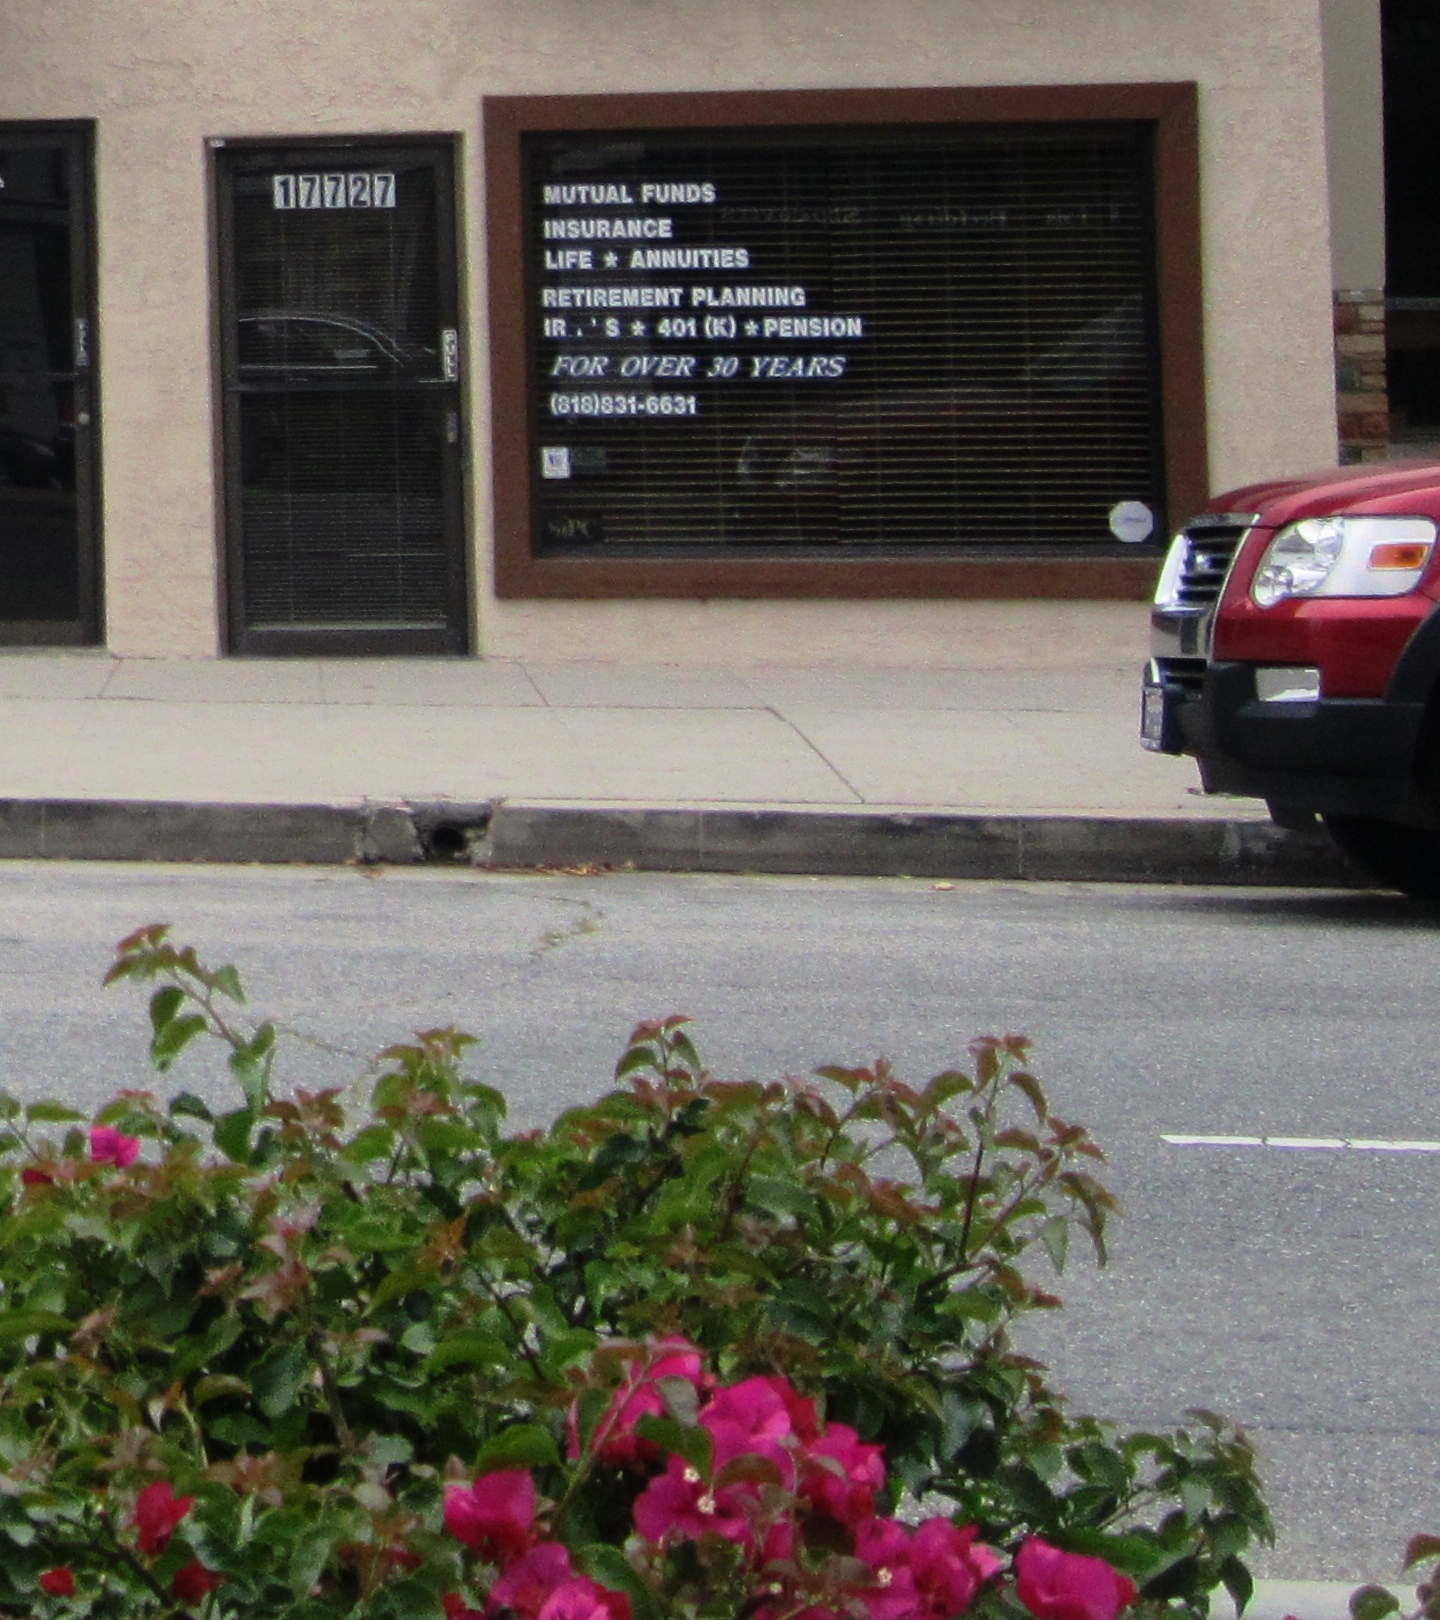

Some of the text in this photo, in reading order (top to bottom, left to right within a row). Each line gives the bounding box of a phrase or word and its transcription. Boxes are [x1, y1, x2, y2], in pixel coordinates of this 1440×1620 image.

[275, 174, 395, 208] 17727
[543, 183, 717, 204] MUTUAL FUNDS
[543, 218, 673, 238] INSURANCE
[544, 248, 750, 269] LIFE ANNUITIES
[542, 287, 806, 307] RETIREMENT PLANNING
[658, 318, 696, 337] 401
[704, 316, 736, 339] (K)
[765, 318, 862, 337] PENSION
[552, 356, 847, 377] FOR OVER 30 YEARS
[550, 393, 696, 415] (818)831-6631
